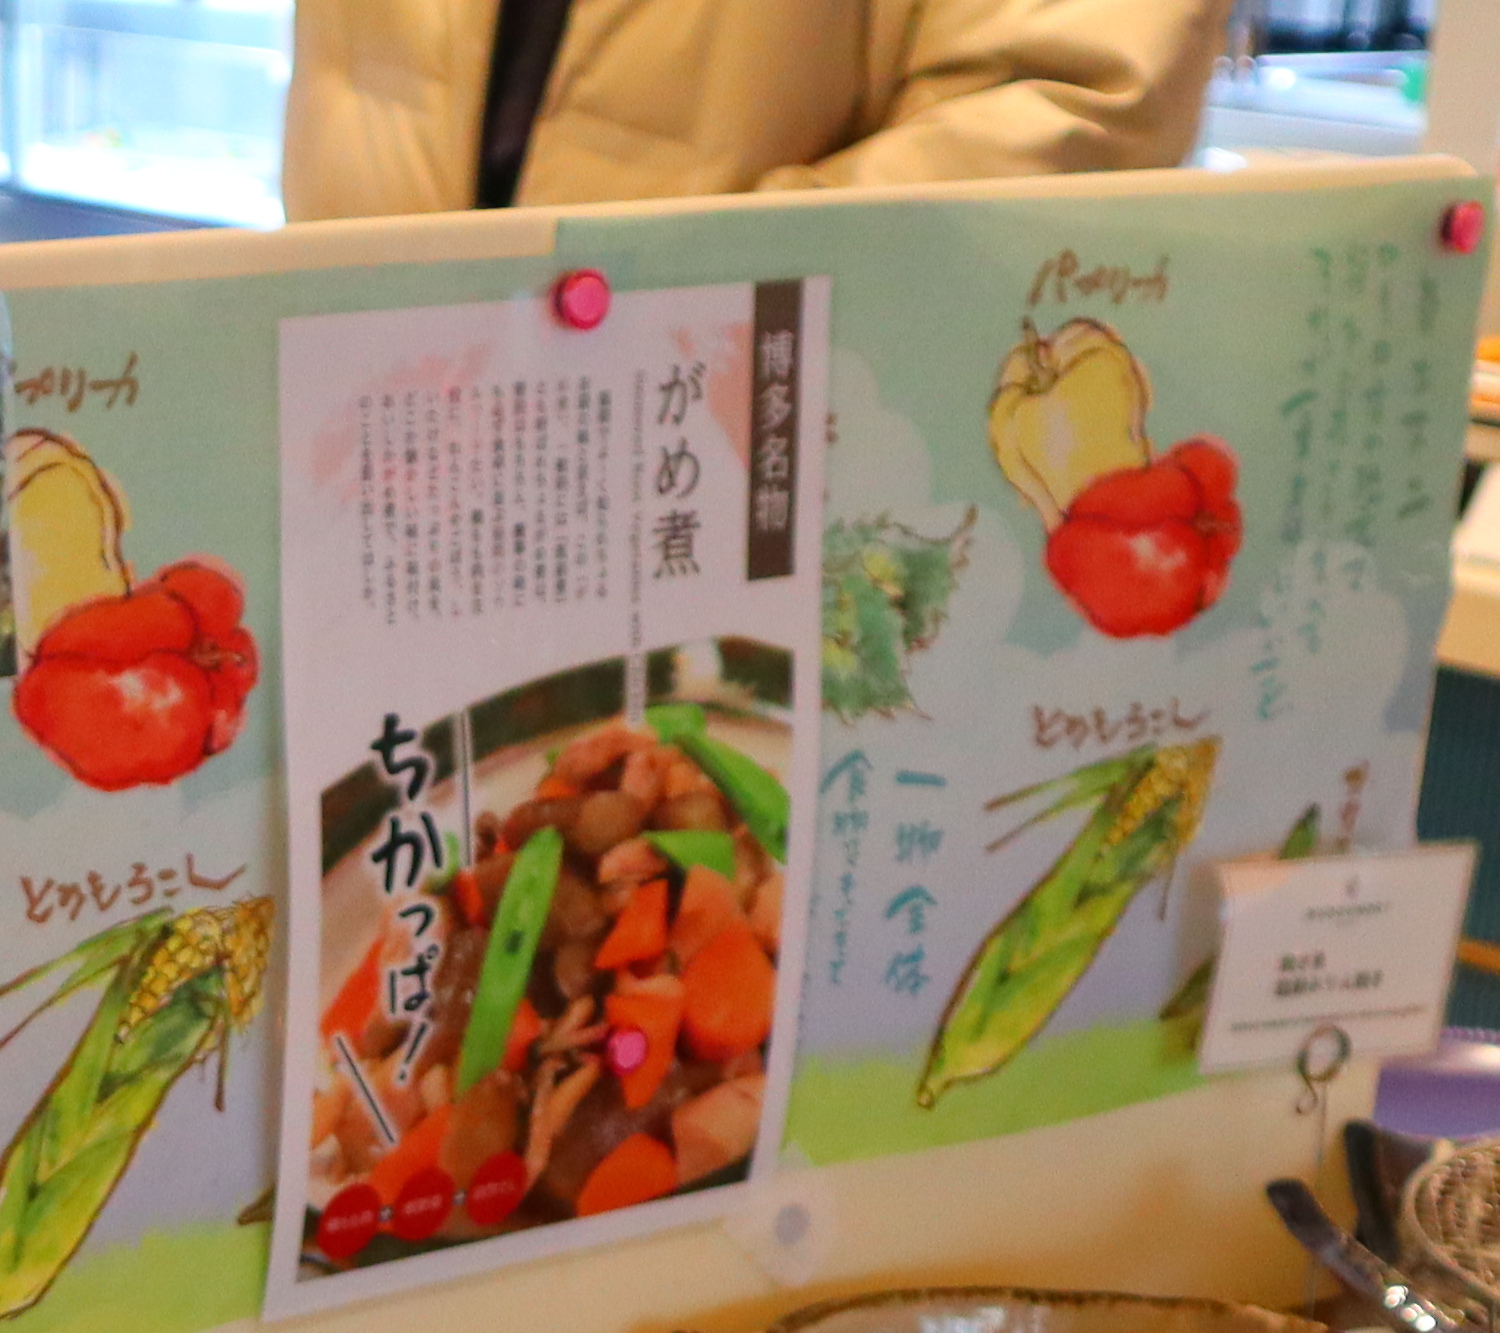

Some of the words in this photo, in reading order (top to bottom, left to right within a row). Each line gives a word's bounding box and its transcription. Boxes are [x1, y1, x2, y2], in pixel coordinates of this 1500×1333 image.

[653, 362, 706, 581] がめ煮
[755, 330, 794, 531] 博多名物
[21, 853, 247, 923] とうもろこし
[371, 712, 441, 1082] ちかっぱ！
